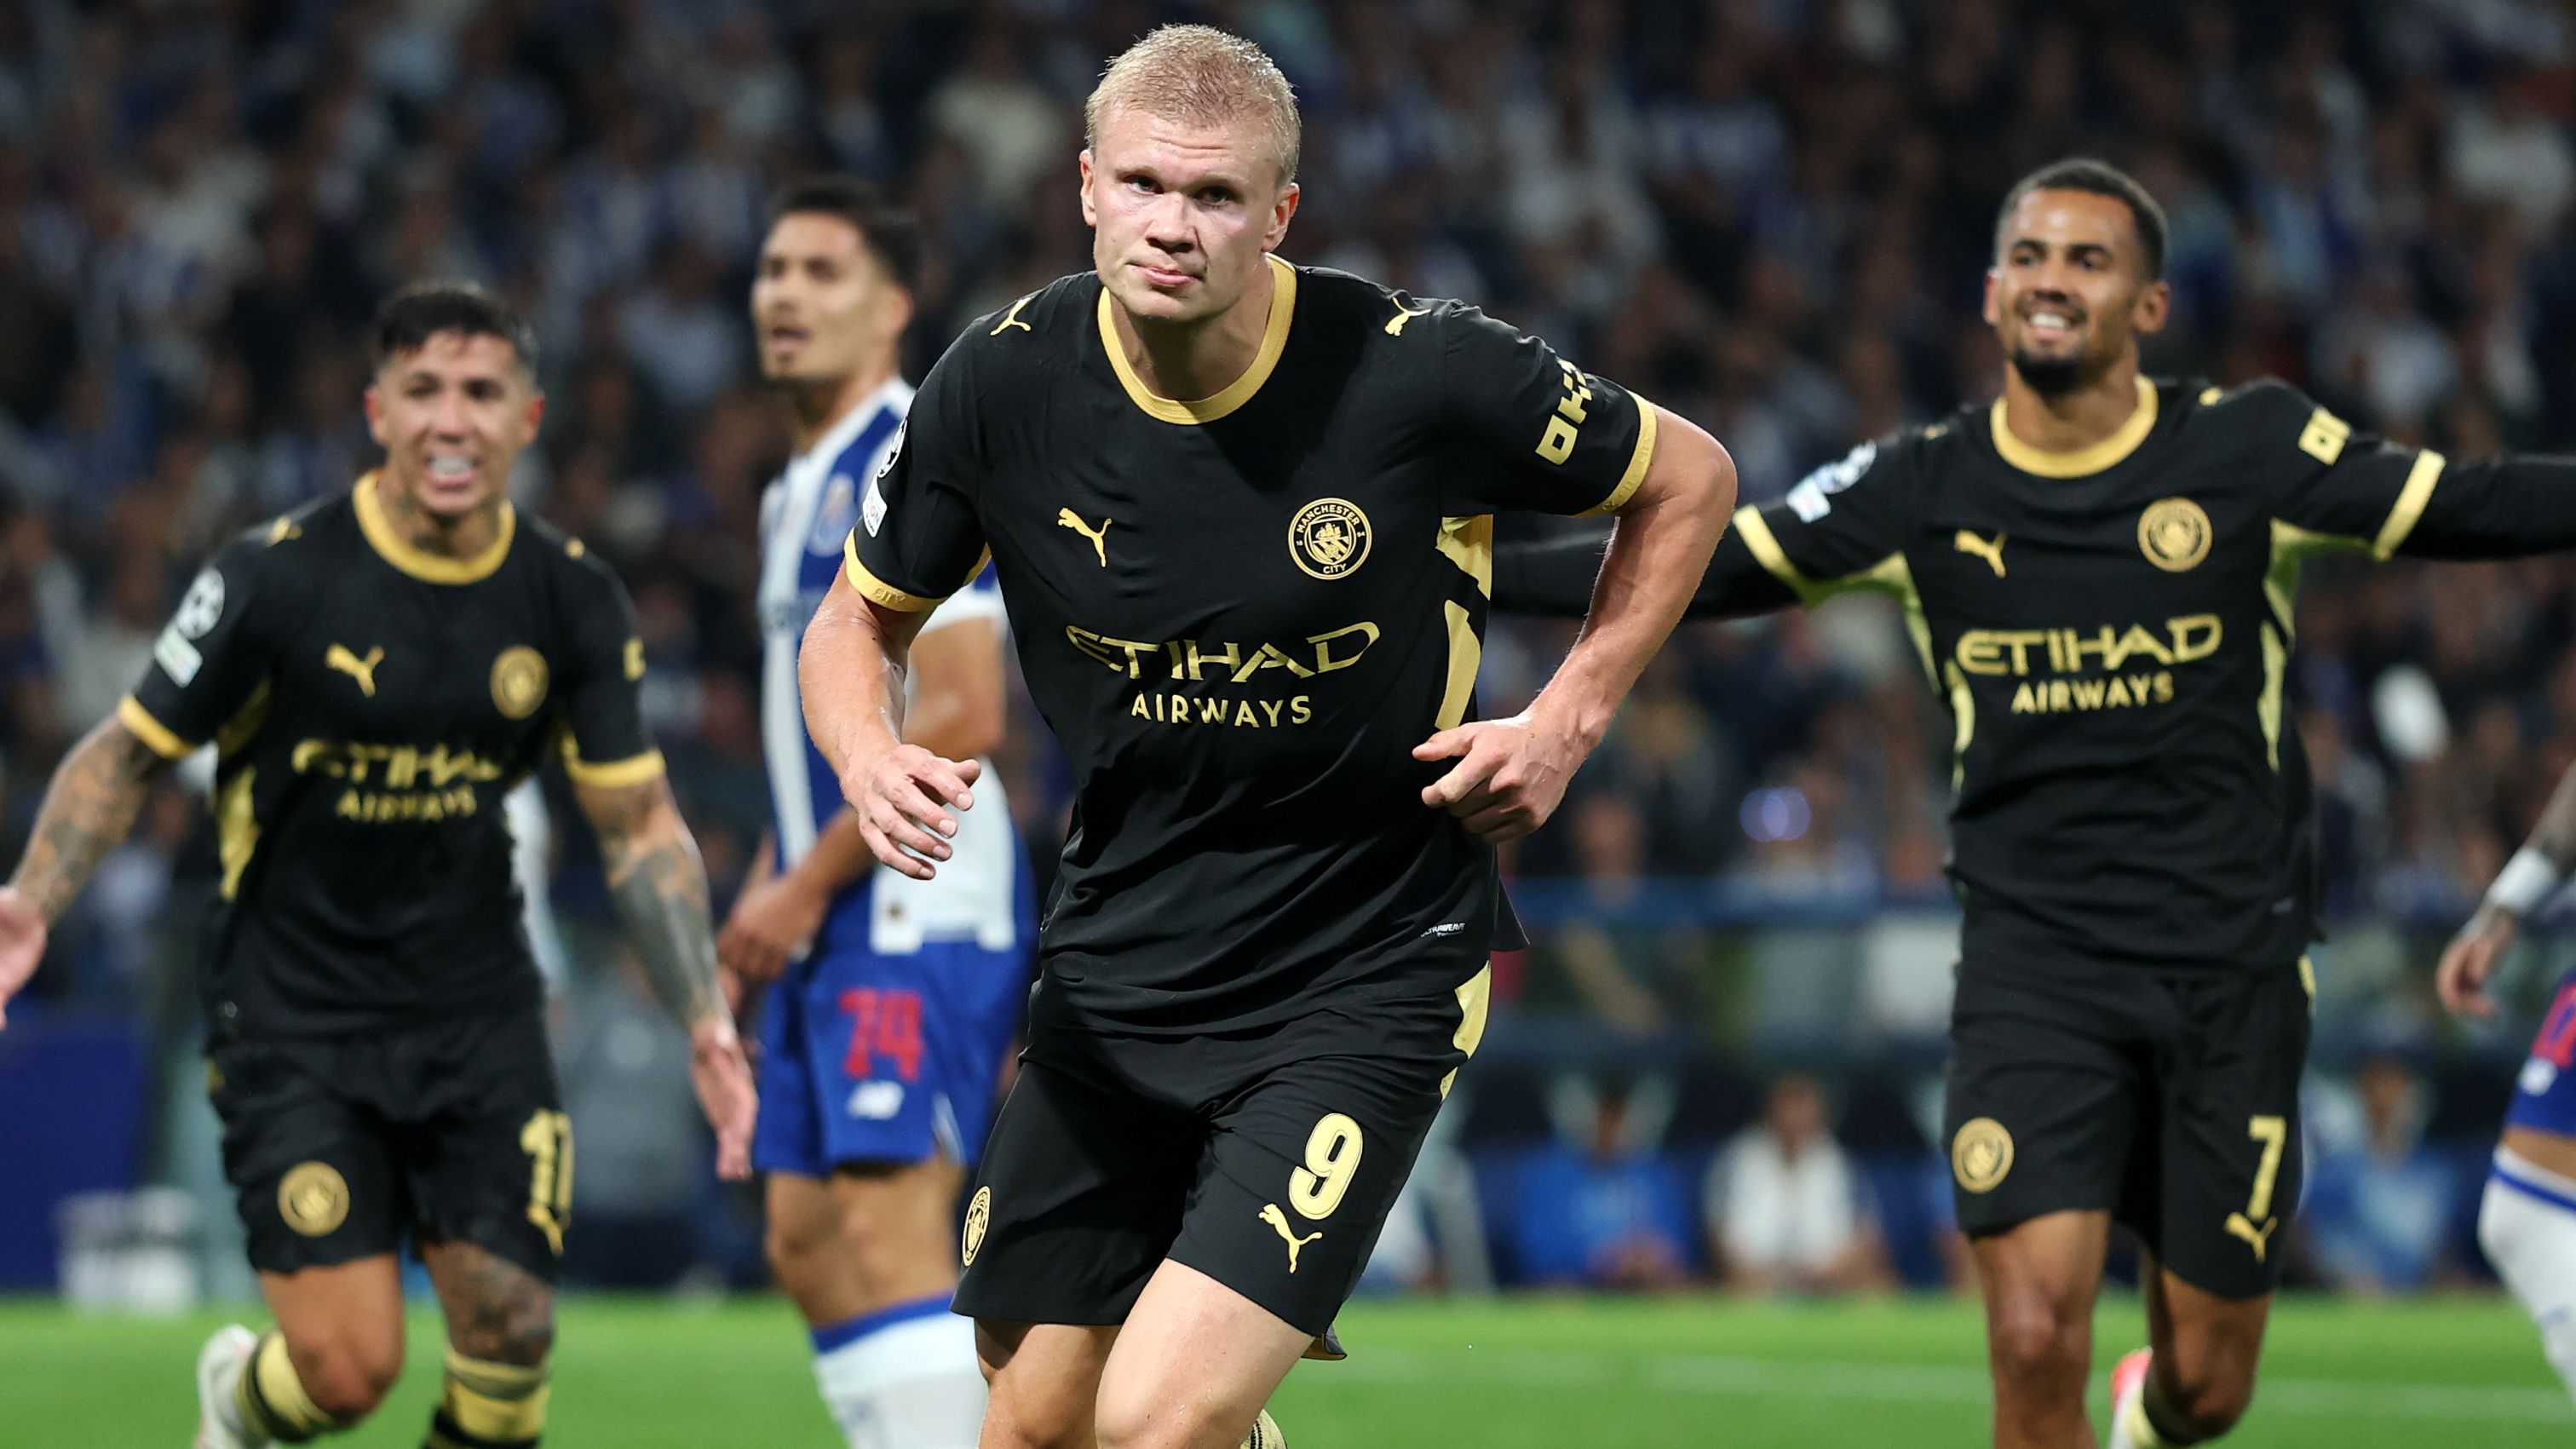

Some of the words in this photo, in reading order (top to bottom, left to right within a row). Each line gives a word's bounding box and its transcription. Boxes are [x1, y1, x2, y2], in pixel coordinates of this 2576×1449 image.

[1296, 504, 1360, 533] MANCHESTER
[1323, 563, 1347, 574] CITY
[1066, 621, 1380, 682] ETIHAD
[1955, 612, 2223, 676] ETIHAD
[1130, 691, 1312, 728] AIRWAYS
[2010, 670, 2174, 715] AIRWAYS
[841, 990, 923, 1083] 74
[1288, 1113, 1364, 1221] 9
[2245, 1113, 2288, 1222] 7
